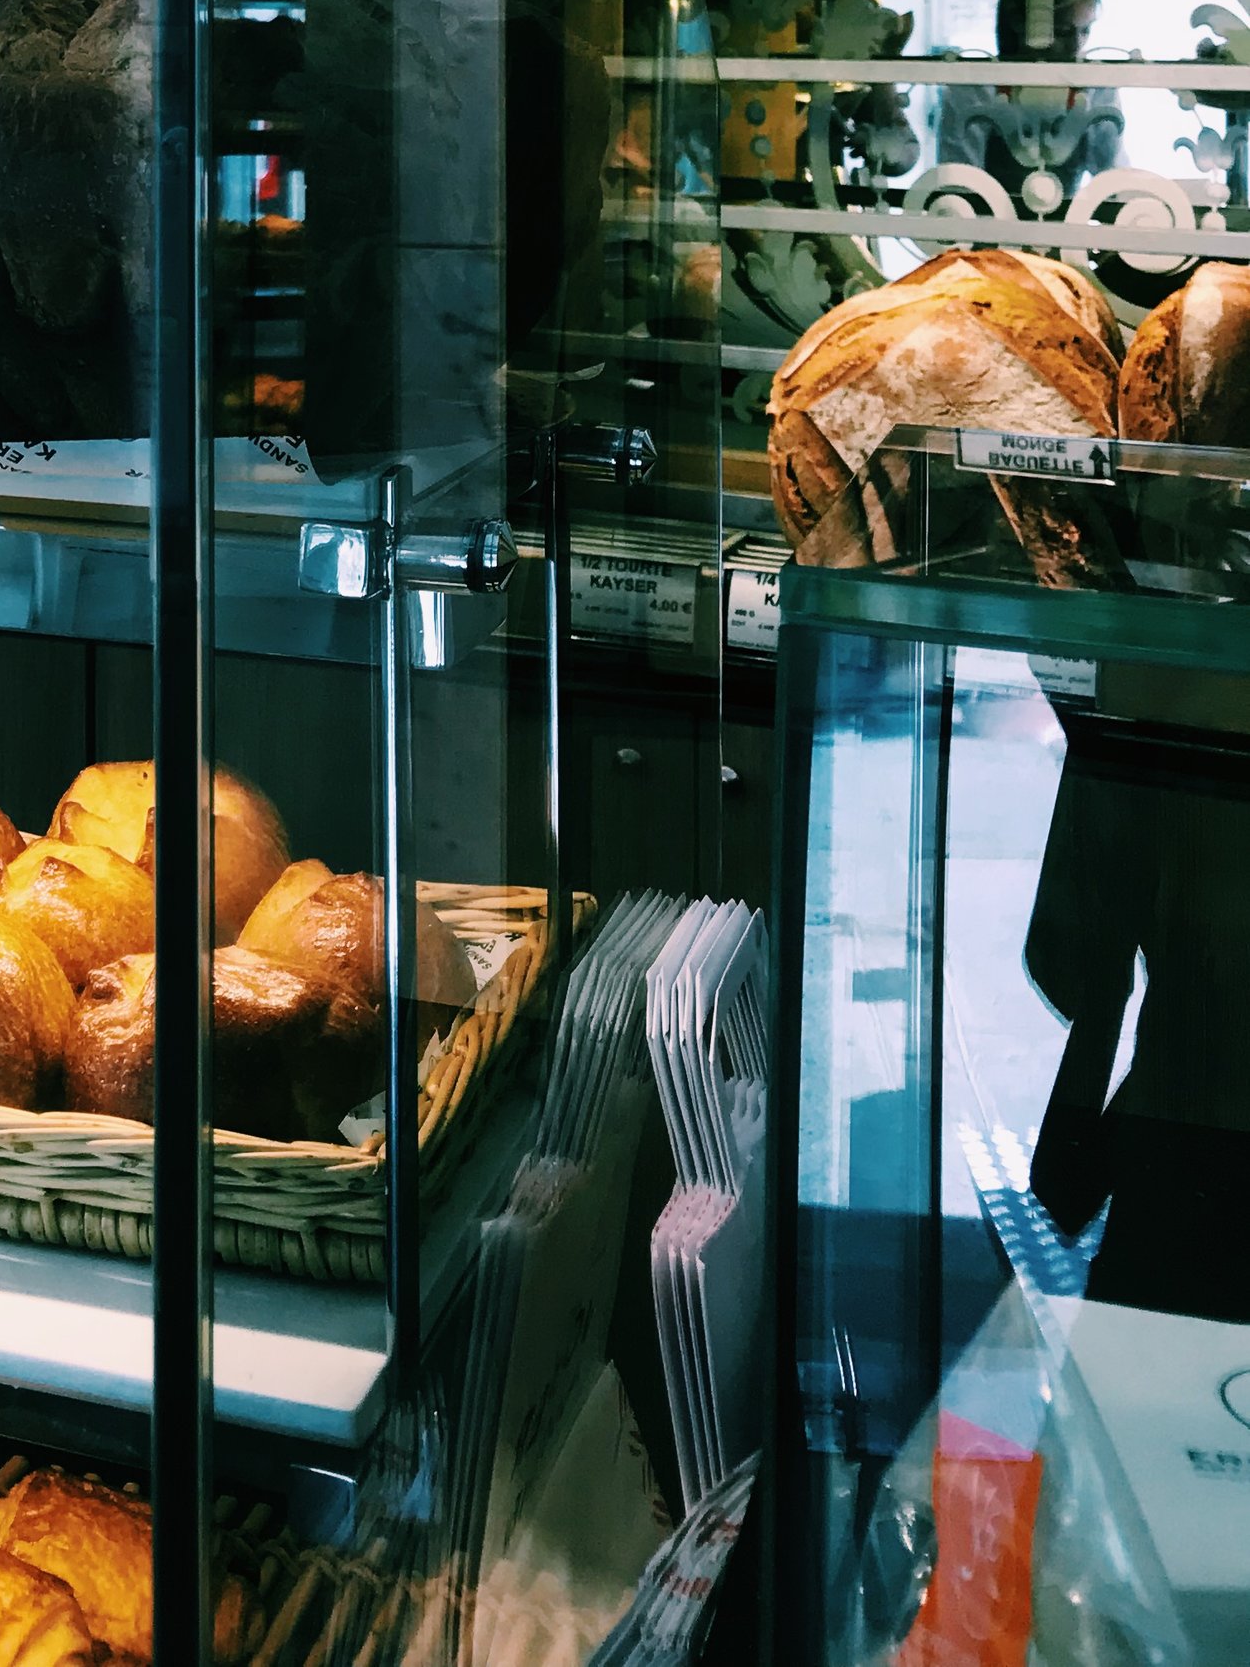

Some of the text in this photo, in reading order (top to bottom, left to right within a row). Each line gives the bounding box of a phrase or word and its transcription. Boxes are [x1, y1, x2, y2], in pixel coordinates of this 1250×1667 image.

[580, 555, 673, 578] 1/2 TOURTE
[589, 574, 658, 594] KAYSER
[756, 574, 777, 587] 1/4
[681, 601, 693, 615] €
